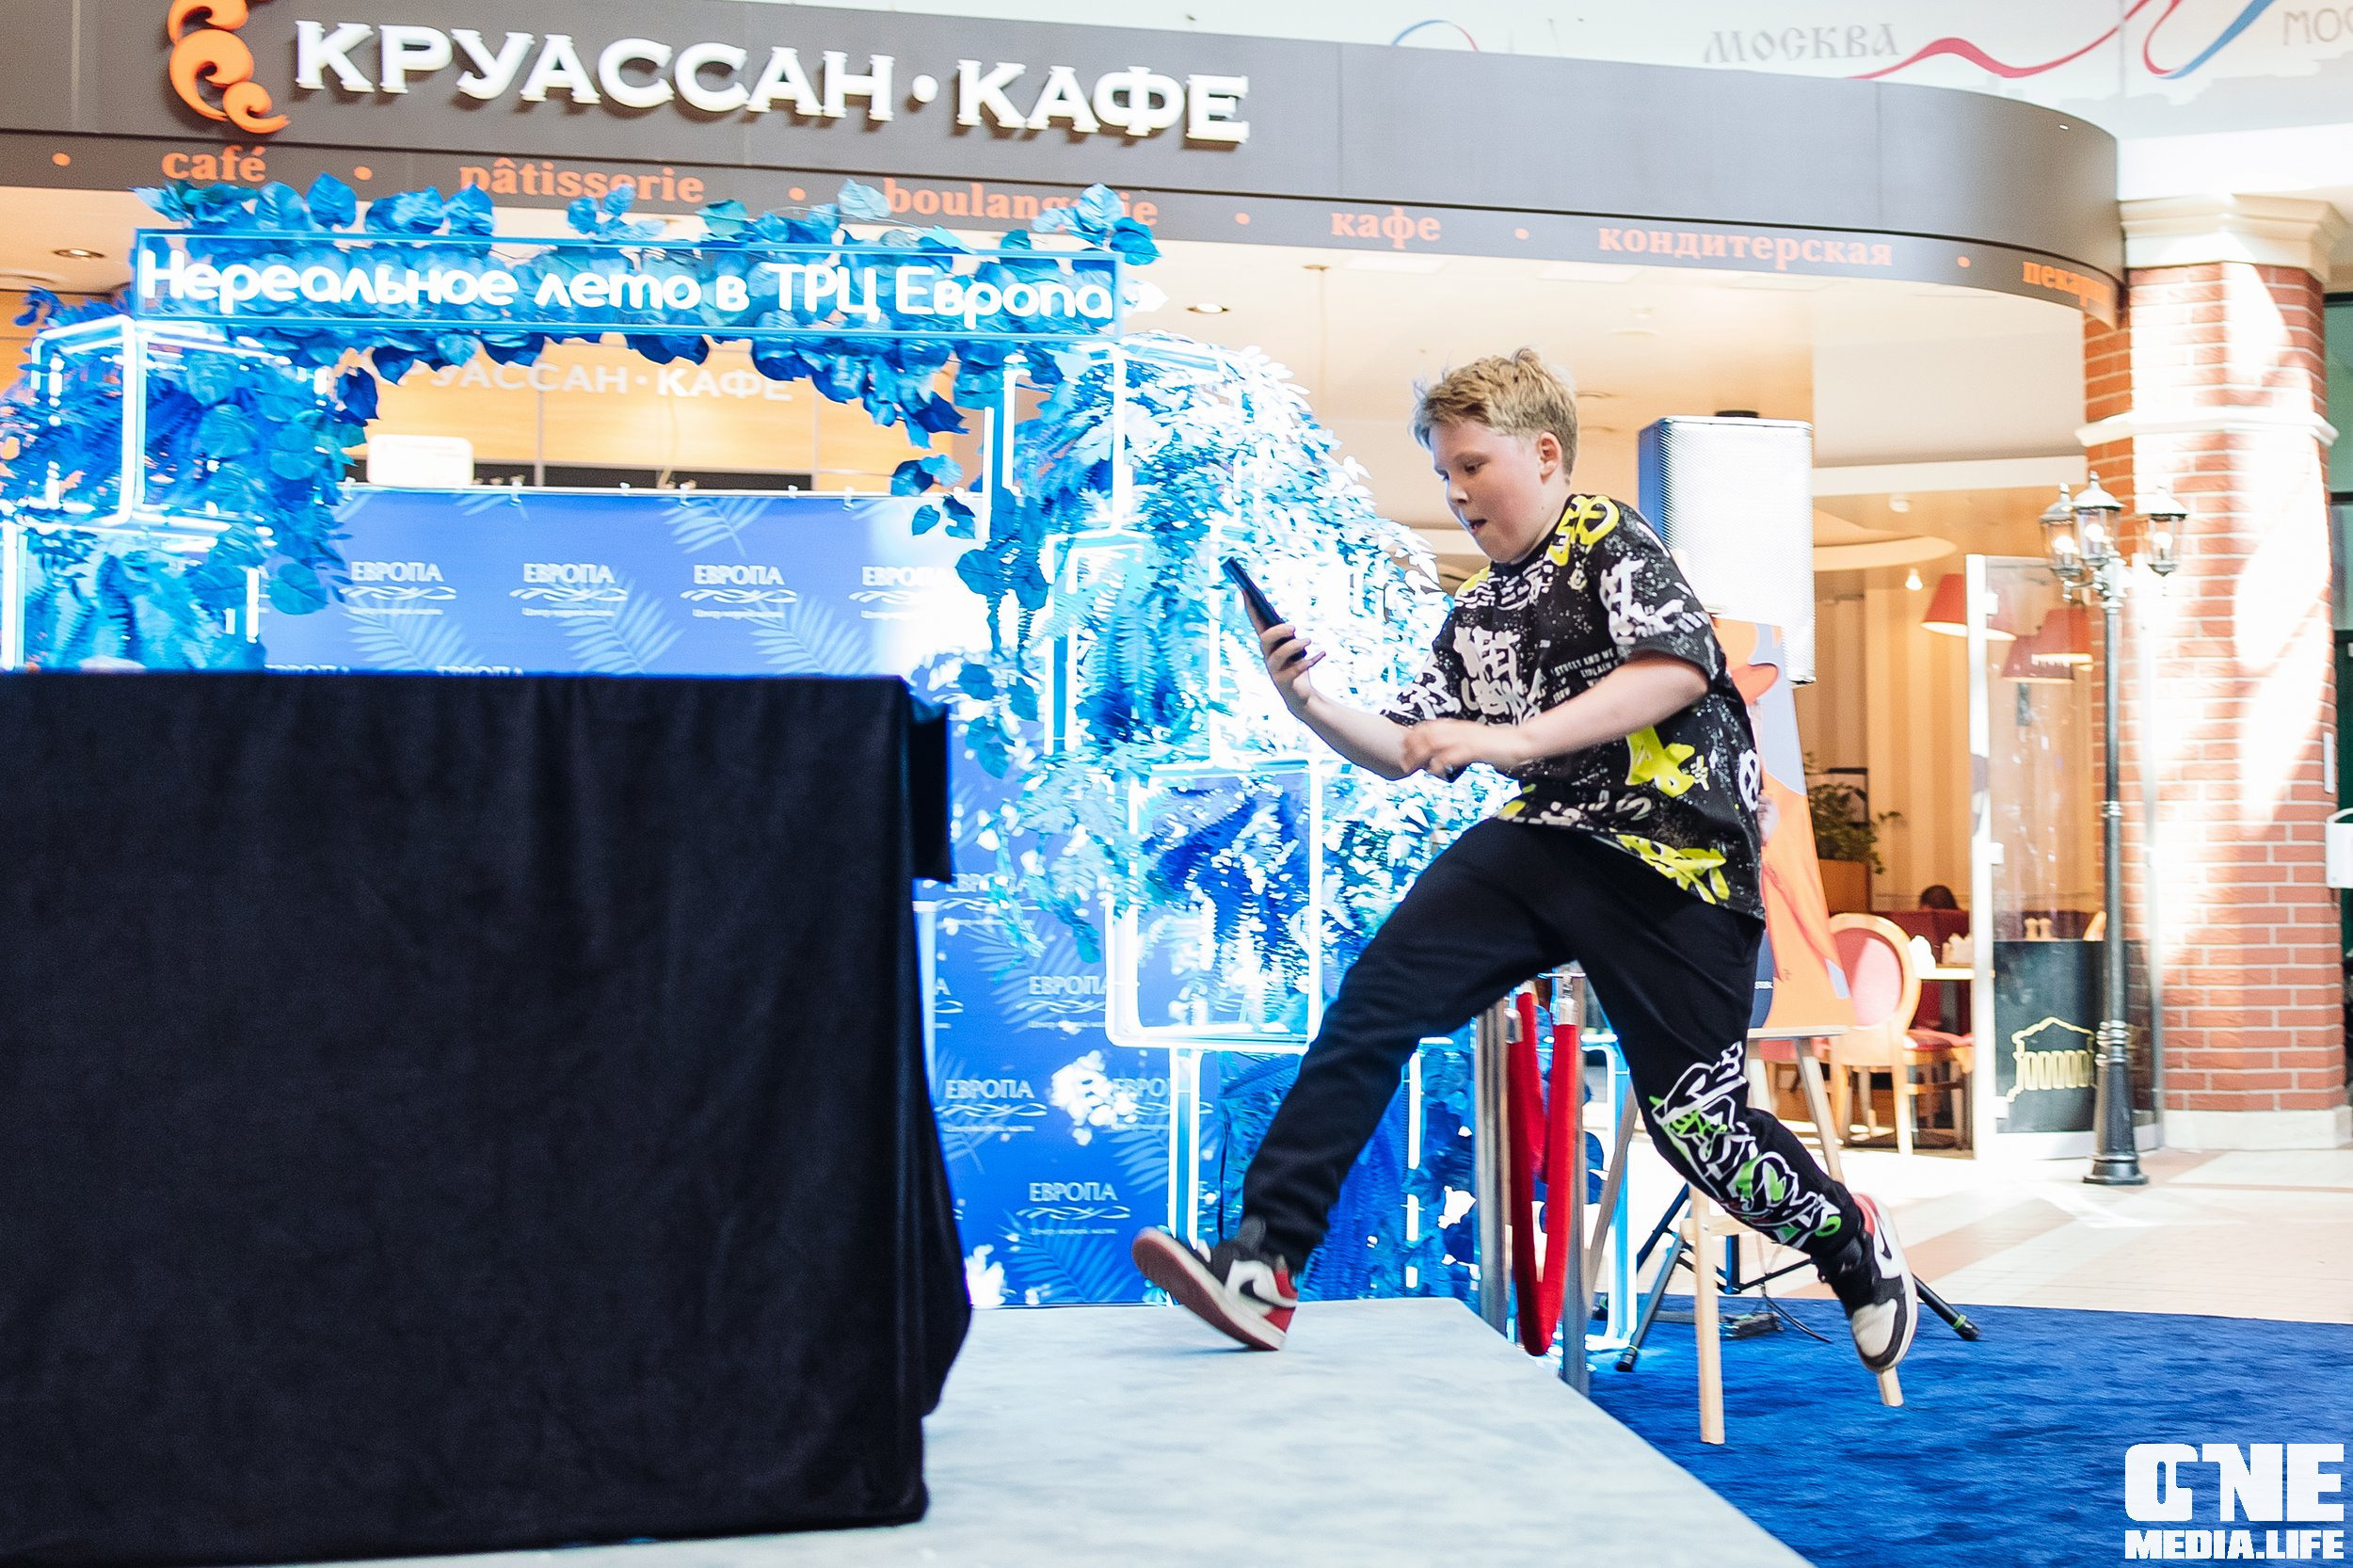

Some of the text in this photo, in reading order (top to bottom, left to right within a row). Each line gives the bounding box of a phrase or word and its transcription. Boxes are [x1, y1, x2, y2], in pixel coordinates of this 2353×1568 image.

[1703, 23, 1901, 63] МОСКВА
[295, 20, 1250, 143] КРУАССАН КАФЕ
[161, 146, 266, 183] café
[1331, 206, 1442, 249] кафе
[1597, 227, 1894, 271] кондитерская
[140, 248, 1114, 330] Нереальное лето в ТРЦ Европа
[656, 366, 794, 402] КАФЕ
[350, 561, 444, 583] ЕВРОПА
[522, 563, 616, 584] ЕВРОПА
[693, 564, 785, 585] ЕВРОПА
[945, 1080, 1035, 1099] ЕВРОПА
[1029, 1182, 1118, 1202] ЕВРОПА
